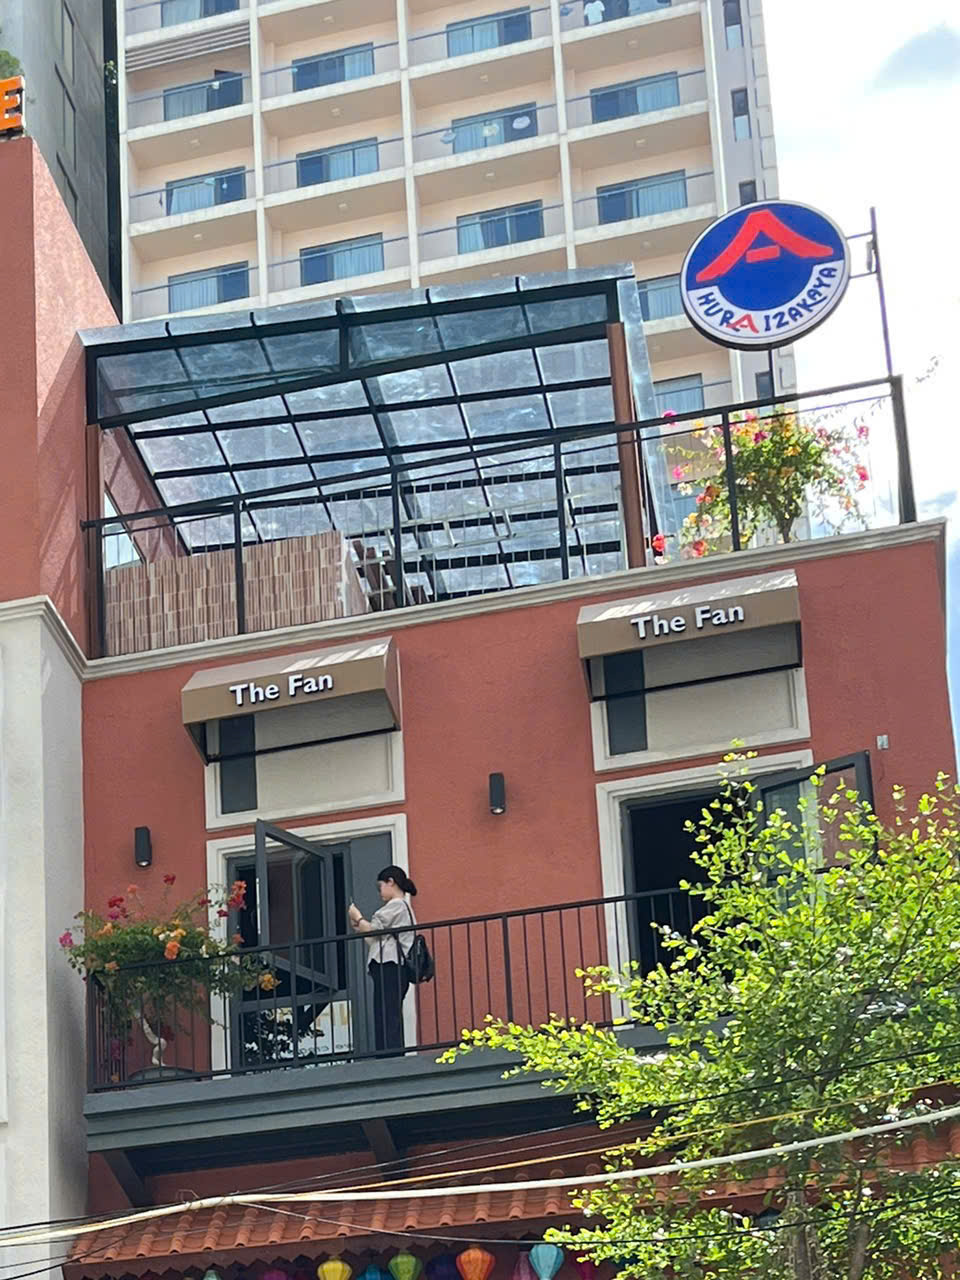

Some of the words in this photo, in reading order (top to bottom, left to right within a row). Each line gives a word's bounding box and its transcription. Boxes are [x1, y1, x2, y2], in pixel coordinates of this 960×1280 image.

[764, 267, 838, 332] IZAKAYA
[629, 615, 690, 640] The
[694, 602, 746, 631] Fan
[228, 681, 281, 707] The
[286, 670, 334, 697] Fan
